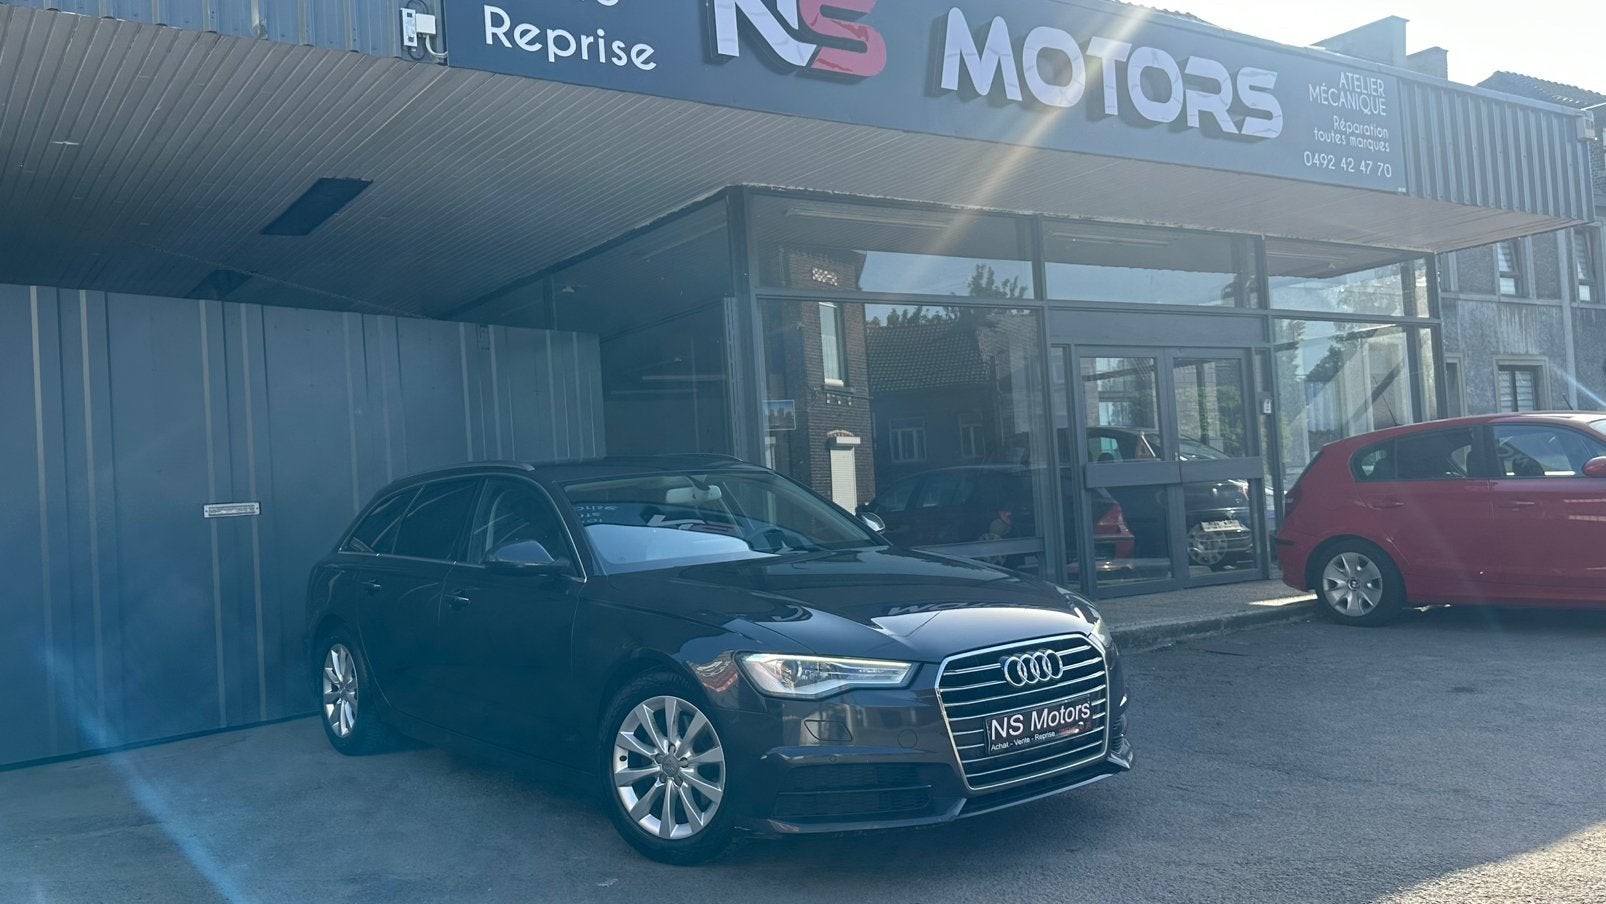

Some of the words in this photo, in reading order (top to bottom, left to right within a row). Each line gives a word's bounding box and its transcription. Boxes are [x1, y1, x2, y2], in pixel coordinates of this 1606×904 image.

[483, 5, 657, 71] Reprise
[714, 0, 887, 77] NS
[941, 7, 1284, 139] MOTORS
[1339, 71, 1385, 97] ATELIER
[1308, 82, 1387, 116] MÉCANIQUE
[1313, 127, 1346, 145] toutes
[1349, 136, 1390, 153] marques
[1333, 115, 1389, 139] Réparation
[1303, 151, 1336, 170] 0492
[1340, 157, 1355, 173] 42
[1359, 160, 1373, 175] 47
[1377, 162, 1392, 178] 70
[991, 714, 1024, 741] NS
[1030, 702, 1091, 732] Motors
[990, 741, 1009, 752] Achat
[1013, 736, 1031, 746] Vente
[1034, 731, 1056, 741] Reprise
